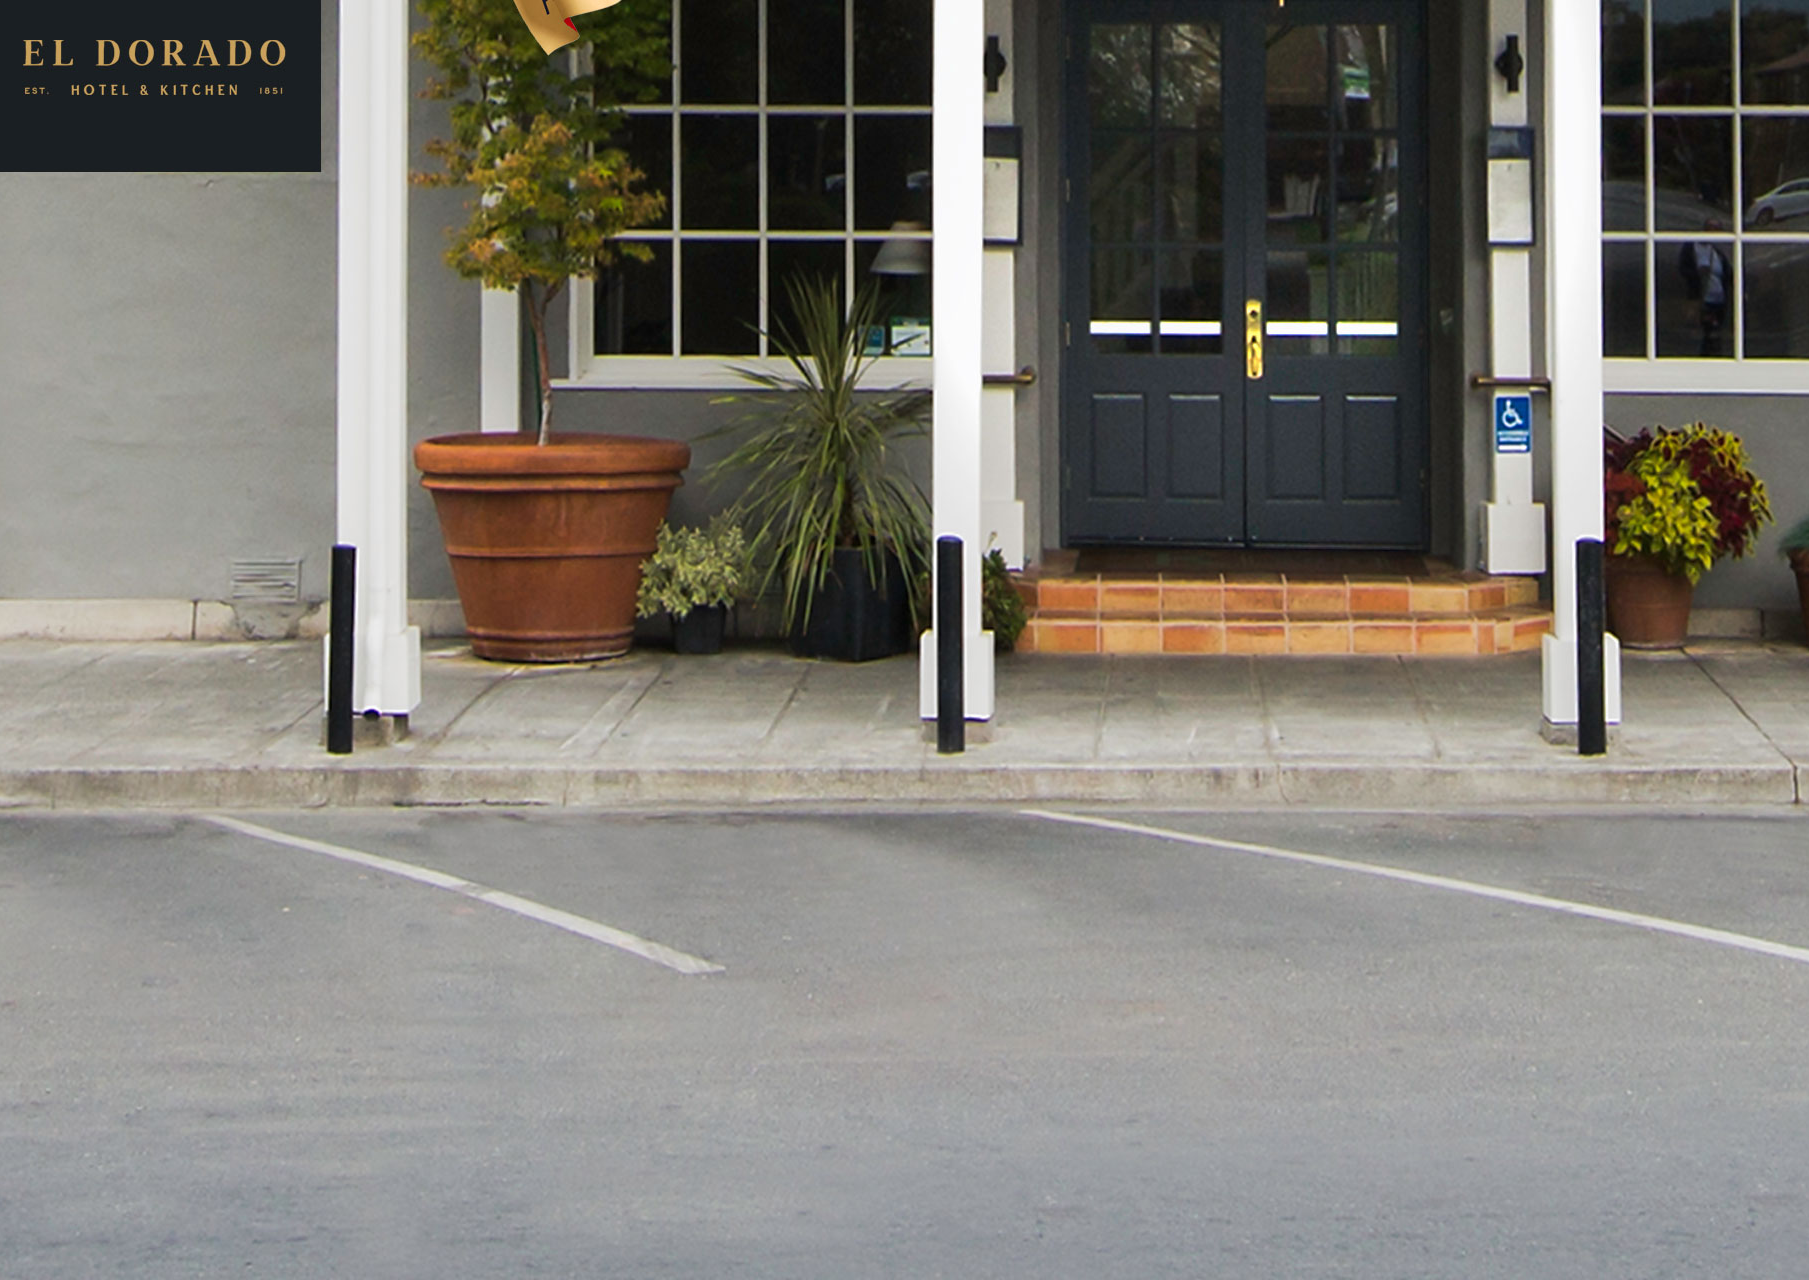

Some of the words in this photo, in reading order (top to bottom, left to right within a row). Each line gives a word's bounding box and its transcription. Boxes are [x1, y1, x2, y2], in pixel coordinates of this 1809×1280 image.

[22, 39, 74, 67] EL
[95, 39, 287, 67] DORADO
[24, 86, 50, 95] EST.
[70, 83, 130, 96] HOTEL
[139, 84, 150, 96] &
[159, 83, 239, 96] KITCHEN
[259, 87, 284, 95] 1851
